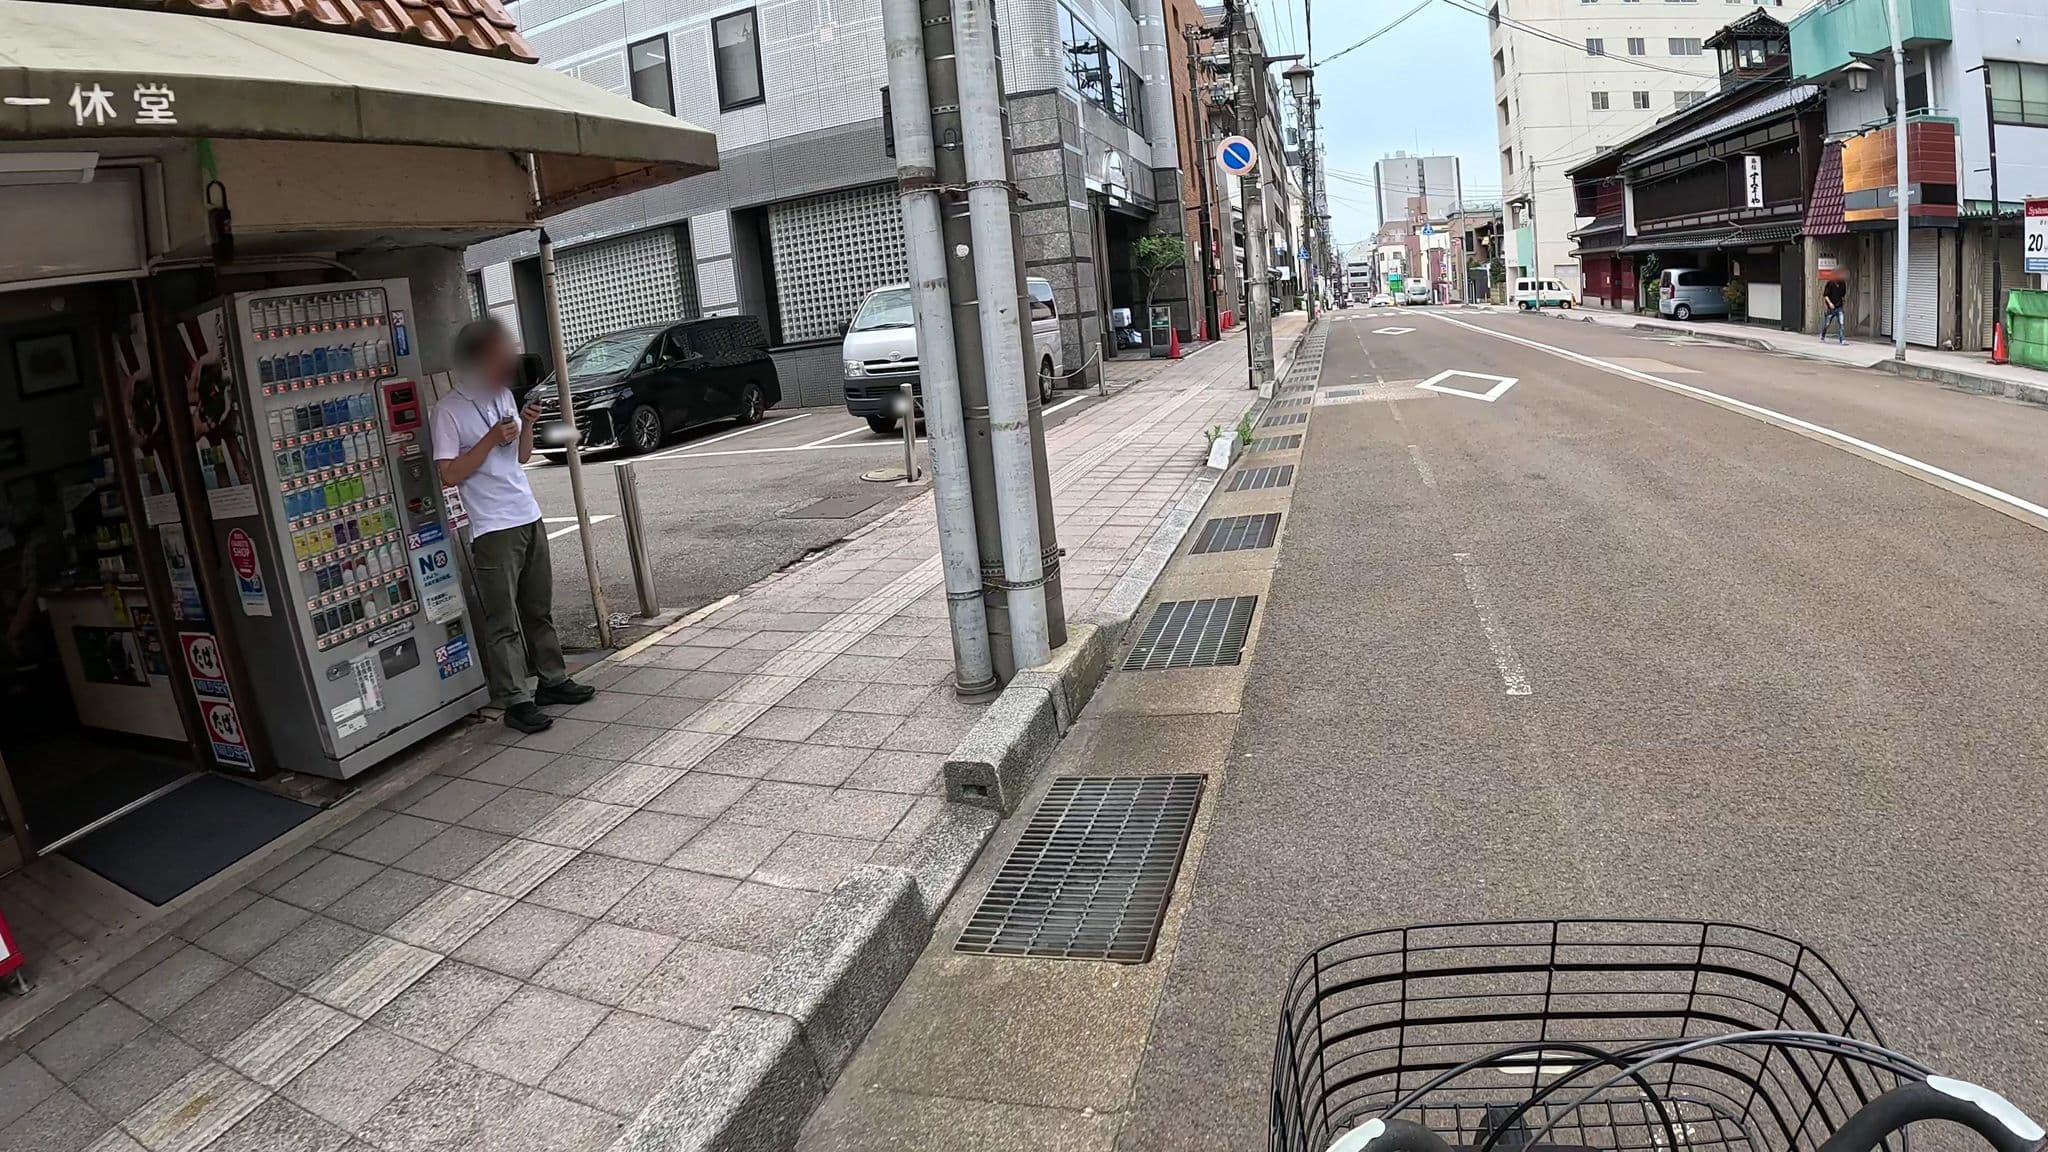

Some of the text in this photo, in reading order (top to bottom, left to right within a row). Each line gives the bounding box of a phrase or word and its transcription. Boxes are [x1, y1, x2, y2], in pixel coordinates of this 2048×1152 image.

[3, 82, 178, 126] 一休堂
[2028, 233, 2043, 252] 20
